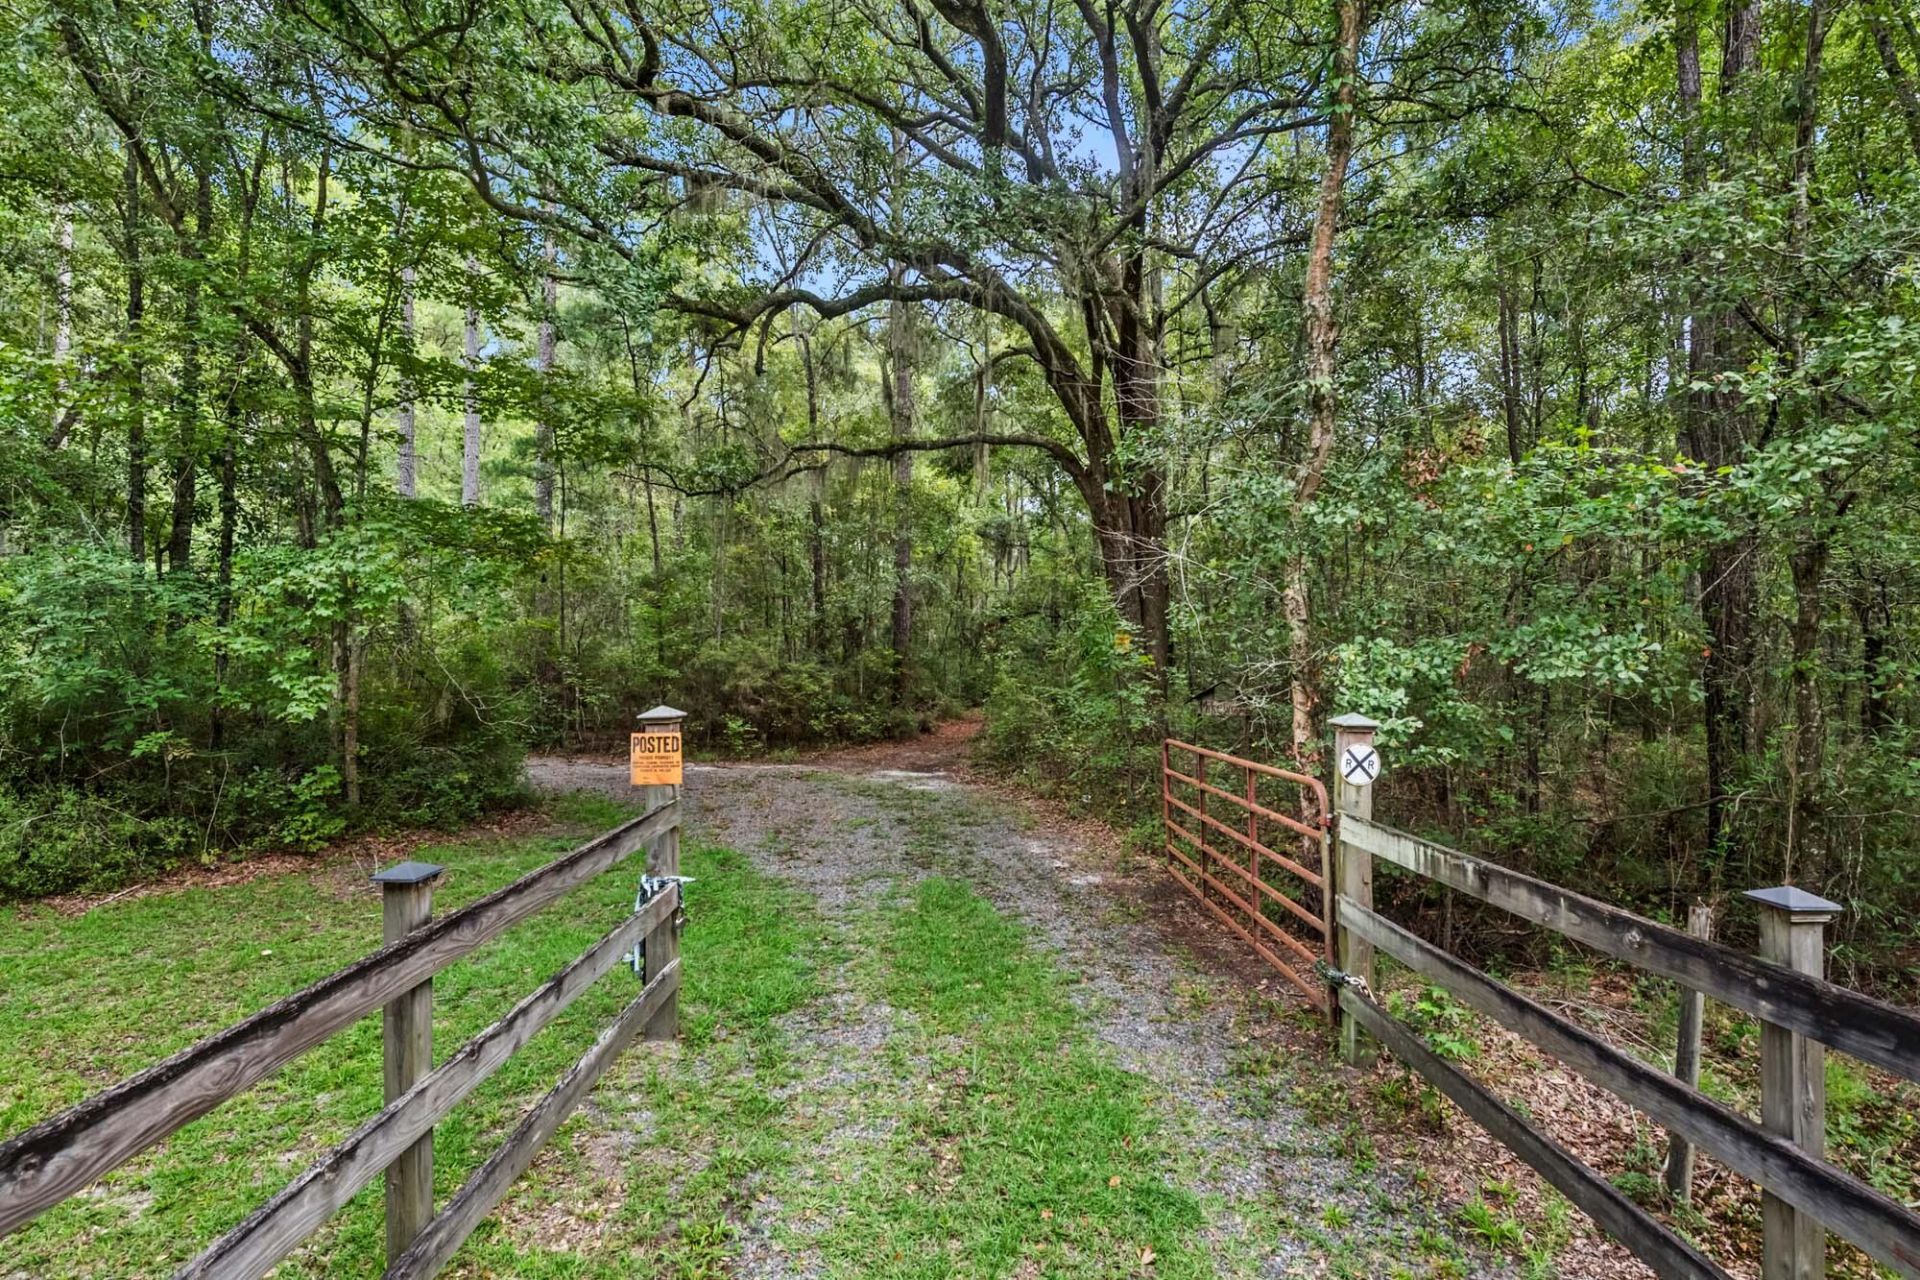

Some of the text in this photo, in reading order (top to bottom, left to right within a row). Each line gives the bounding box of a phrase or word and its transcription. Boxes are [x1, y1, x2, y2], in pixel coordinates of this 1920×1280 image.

[632, 736, 680, 753] POSTED
[1345, 758, 1352, 768] R
[1367, 759, 1374, 770] R
